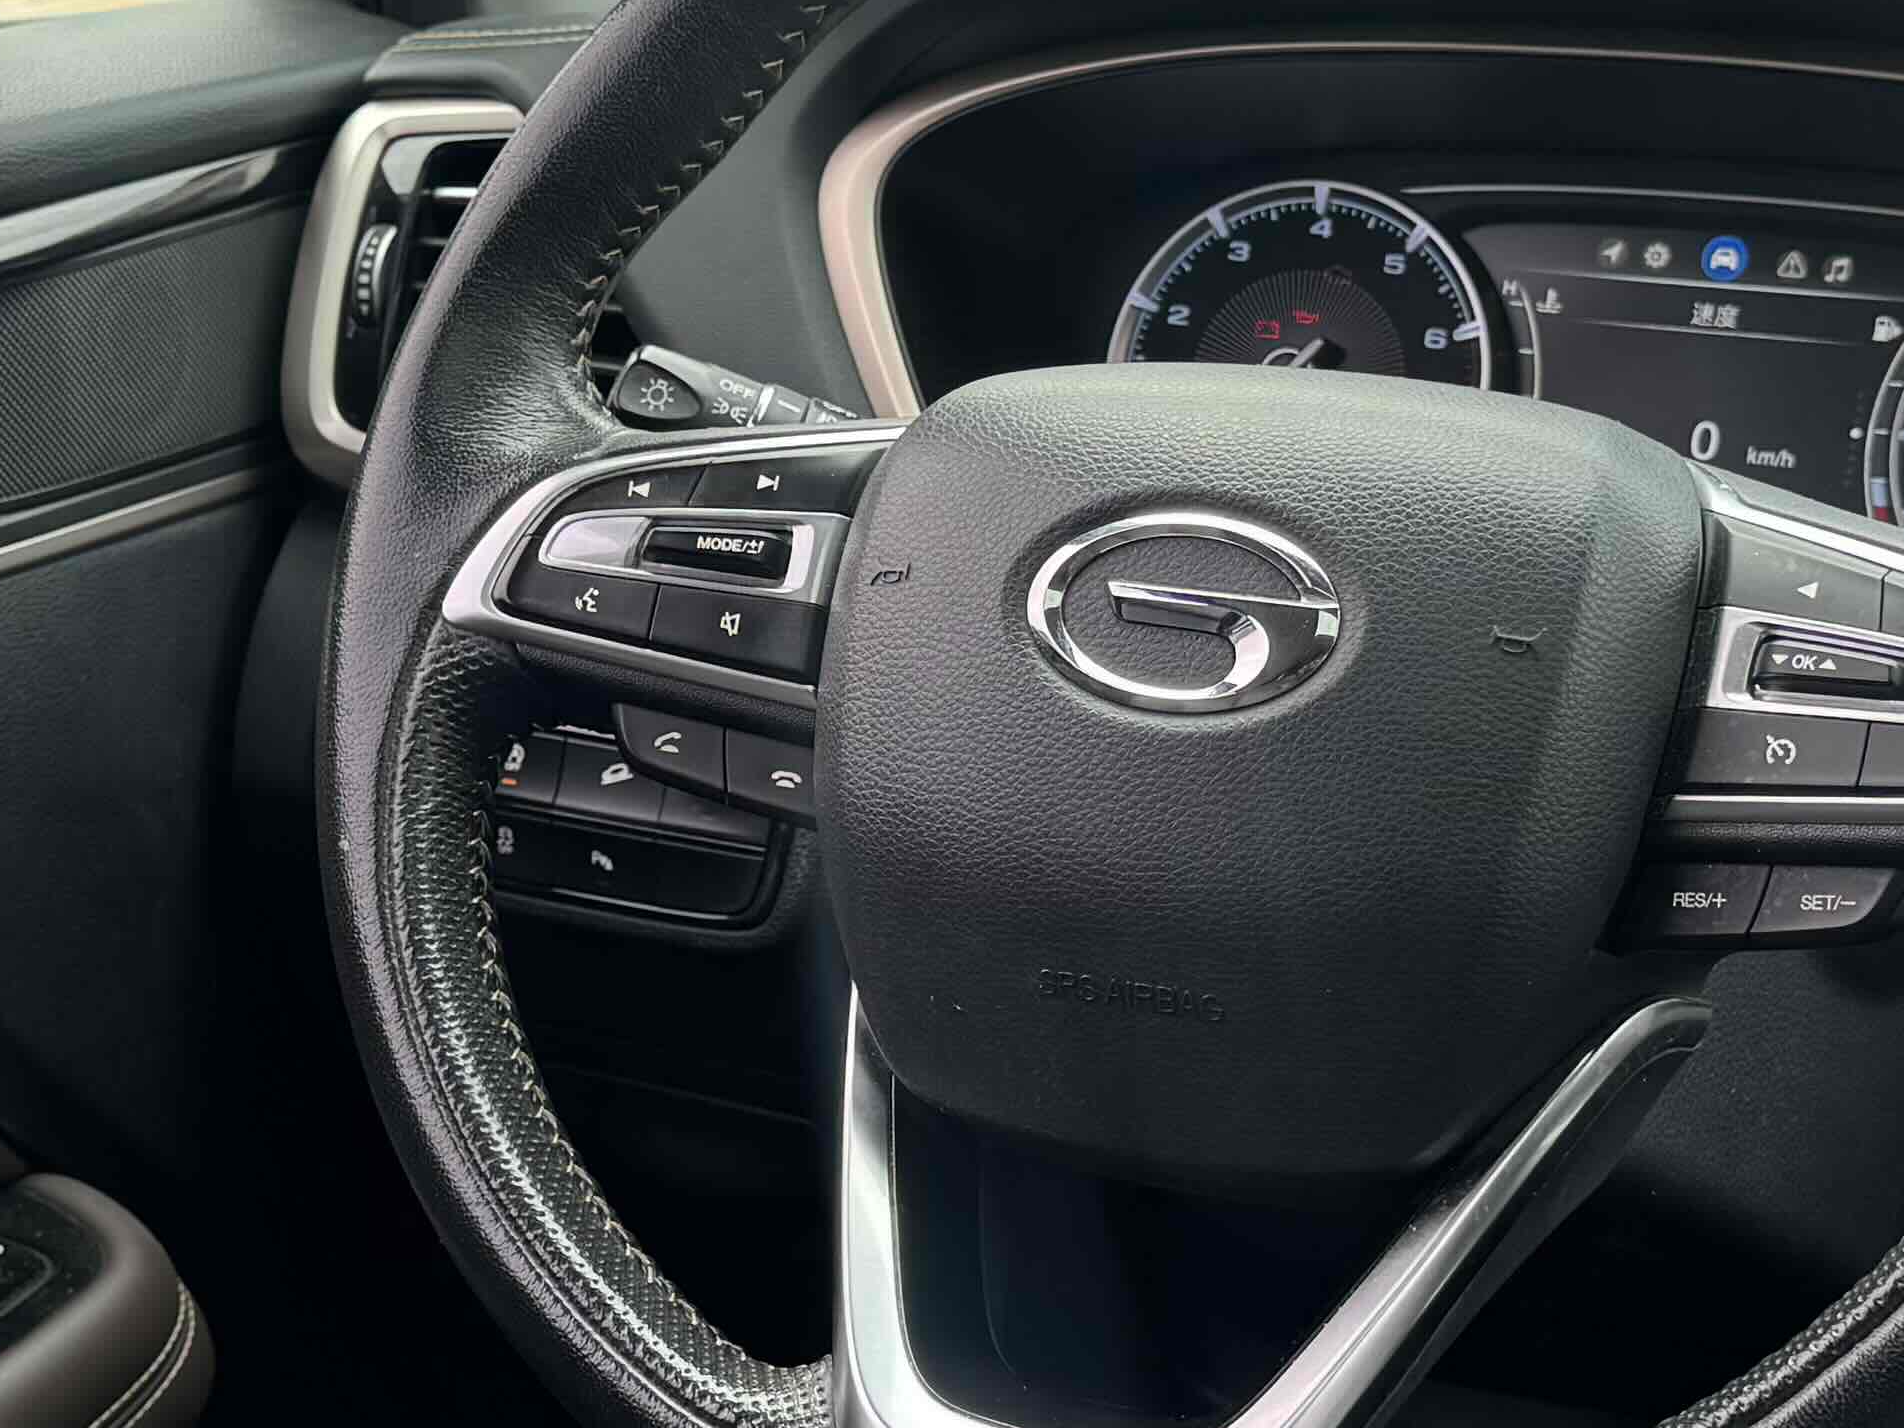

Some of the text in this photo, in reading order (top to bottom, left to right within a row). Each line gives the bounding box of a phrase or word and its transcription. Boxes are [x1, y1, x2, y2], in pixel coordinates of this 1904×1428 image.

[1309, 218, 1333, 239] 4
[1228, 242, 1251, 262] 3
[1383, 254, 1407, 275] 5
[1167, 304, 1190, 326] 2
[1689, 301, 1741, 331] 速度
[1423, 328, 1448, 349] 6
[719, 378, 757, 399] OFF
[1690, 420, 1796, 469] 0 km/h
[1792, 653, 1818, 672] OK
